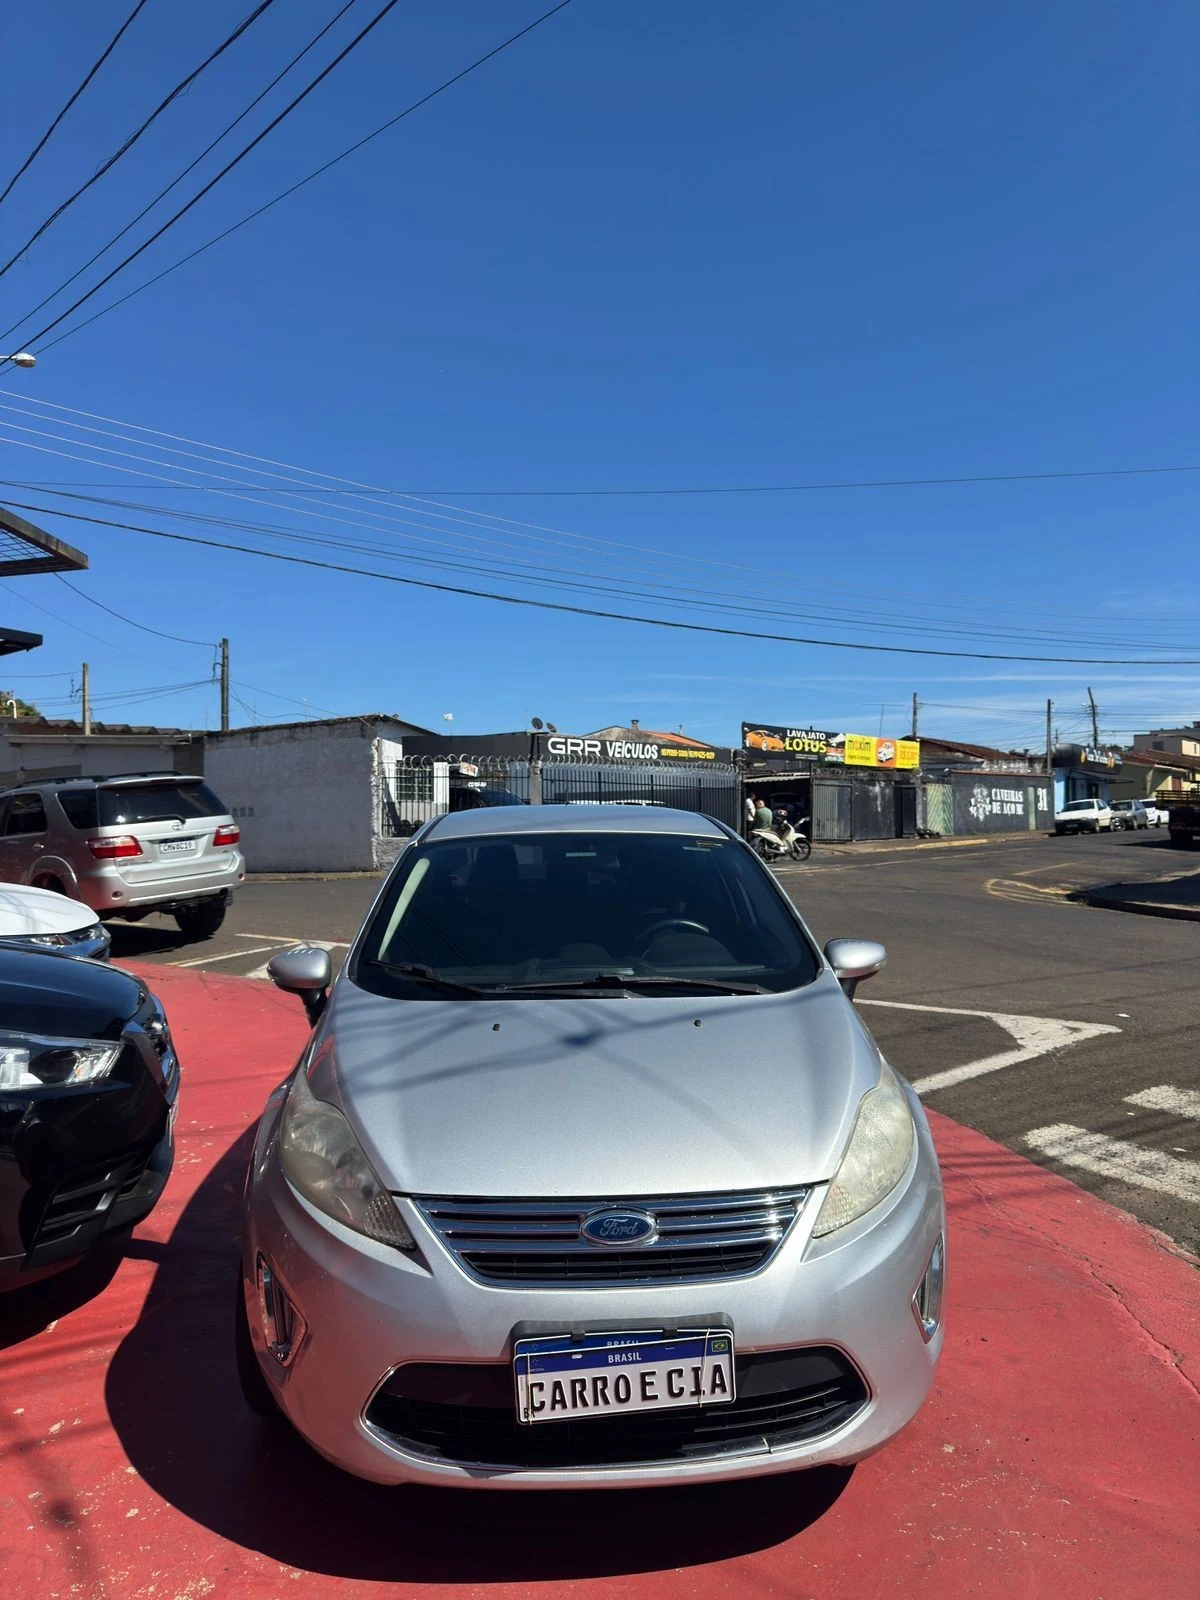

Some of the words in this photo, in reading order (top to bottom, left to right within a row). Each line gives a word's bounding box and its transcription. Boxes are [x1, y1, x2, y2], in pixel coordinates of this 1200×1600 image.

[786, 729, 807, 739] LAVA
[547, 737, 601, 756] GRR
[606, 740, 659, 760] VEÍCULOS
[785, 738, 827, 753] LOTUS
[1037, 787, 1048, 811] 31
[991, 801, 1002, 814] DE
[1003, 802, 1016, 816] AÇO
[600, 1218, 639, 1237] Ford
[608, 1352, 642, 1364] BRASIL
[530, 1374, 632, 1412] CARRO
[640, 1371, 659, 1401] E
[667, 1363, 728, 1399] CIA
